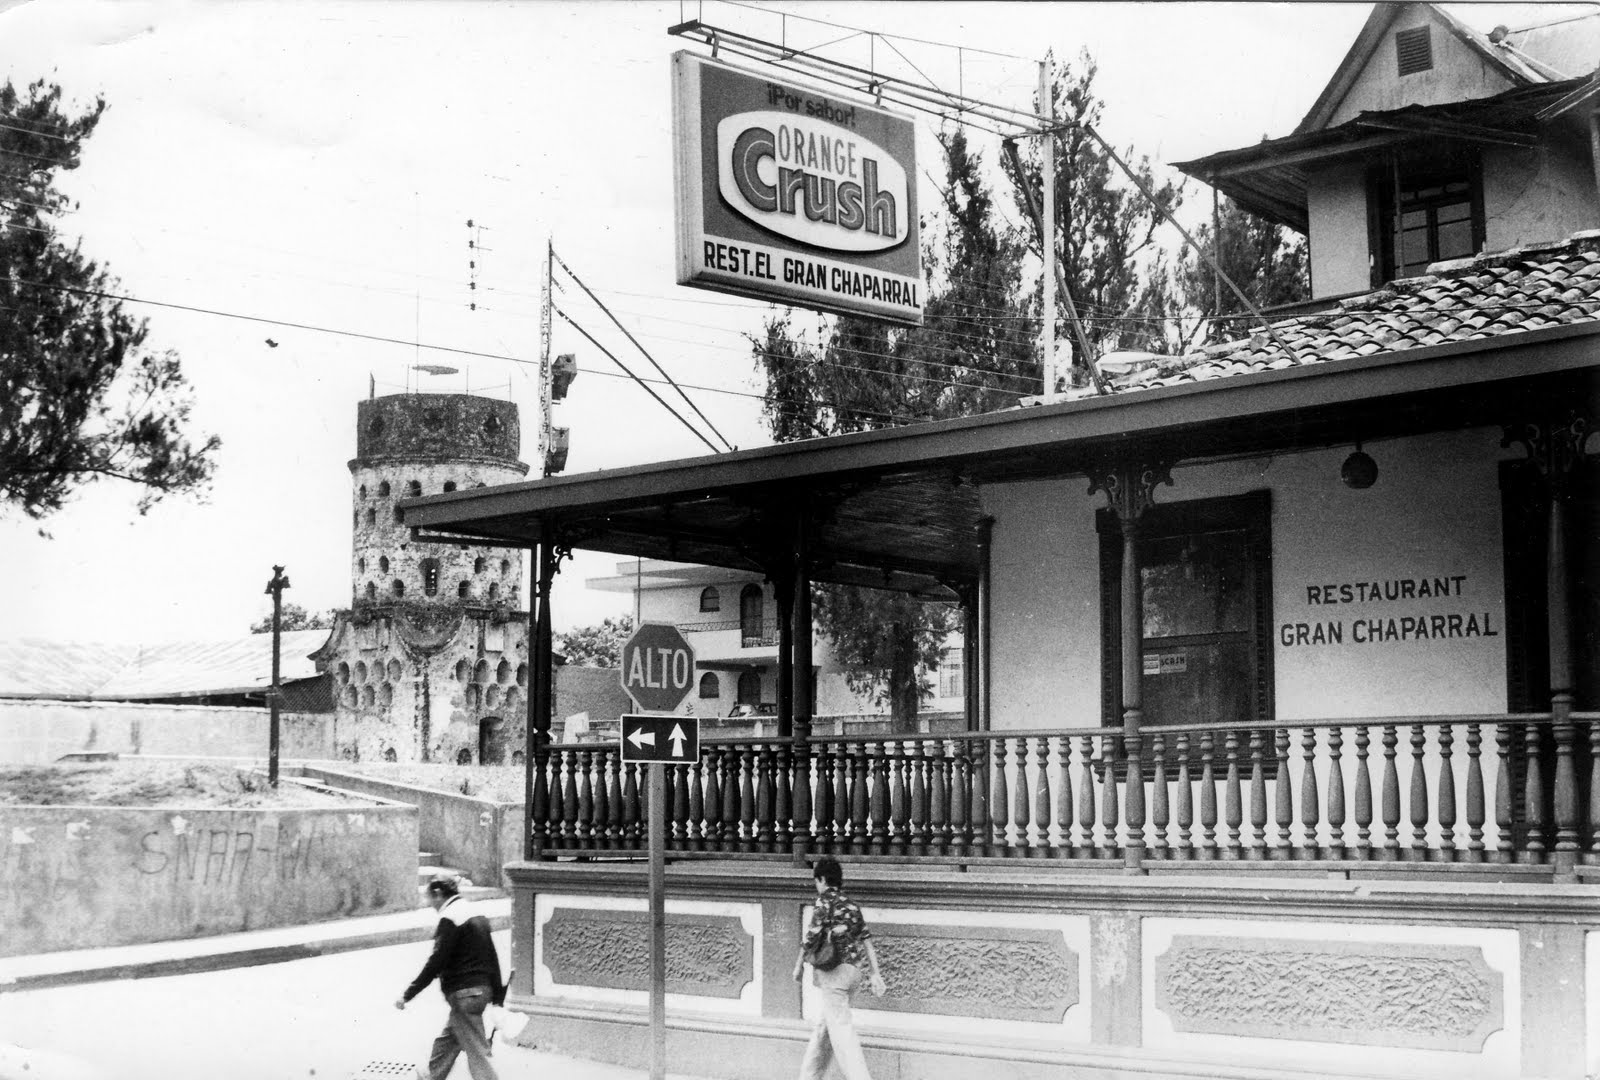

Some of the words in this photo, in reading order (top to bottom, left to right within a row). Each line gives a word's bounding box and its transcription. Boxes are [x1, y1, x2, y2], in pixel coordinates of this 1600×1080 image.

[767, 82, 802, 112] ¡Por
[806, 98, 856, 128] sabor!
[778, 124, 857, 178] ORANGE
[732, 127, 896, 239] Crush
[784, 257, 827, 290] GRAN
[832, 267, 920, 309] CHAPARRAL
[1307, 575, 1467, 605] RESTAURANT
[1281, 622, 1343, 647] GRAN
[1352, 612, 1498, 643] CHAPARRAL
[627, 646, 689, 689] ALTO
